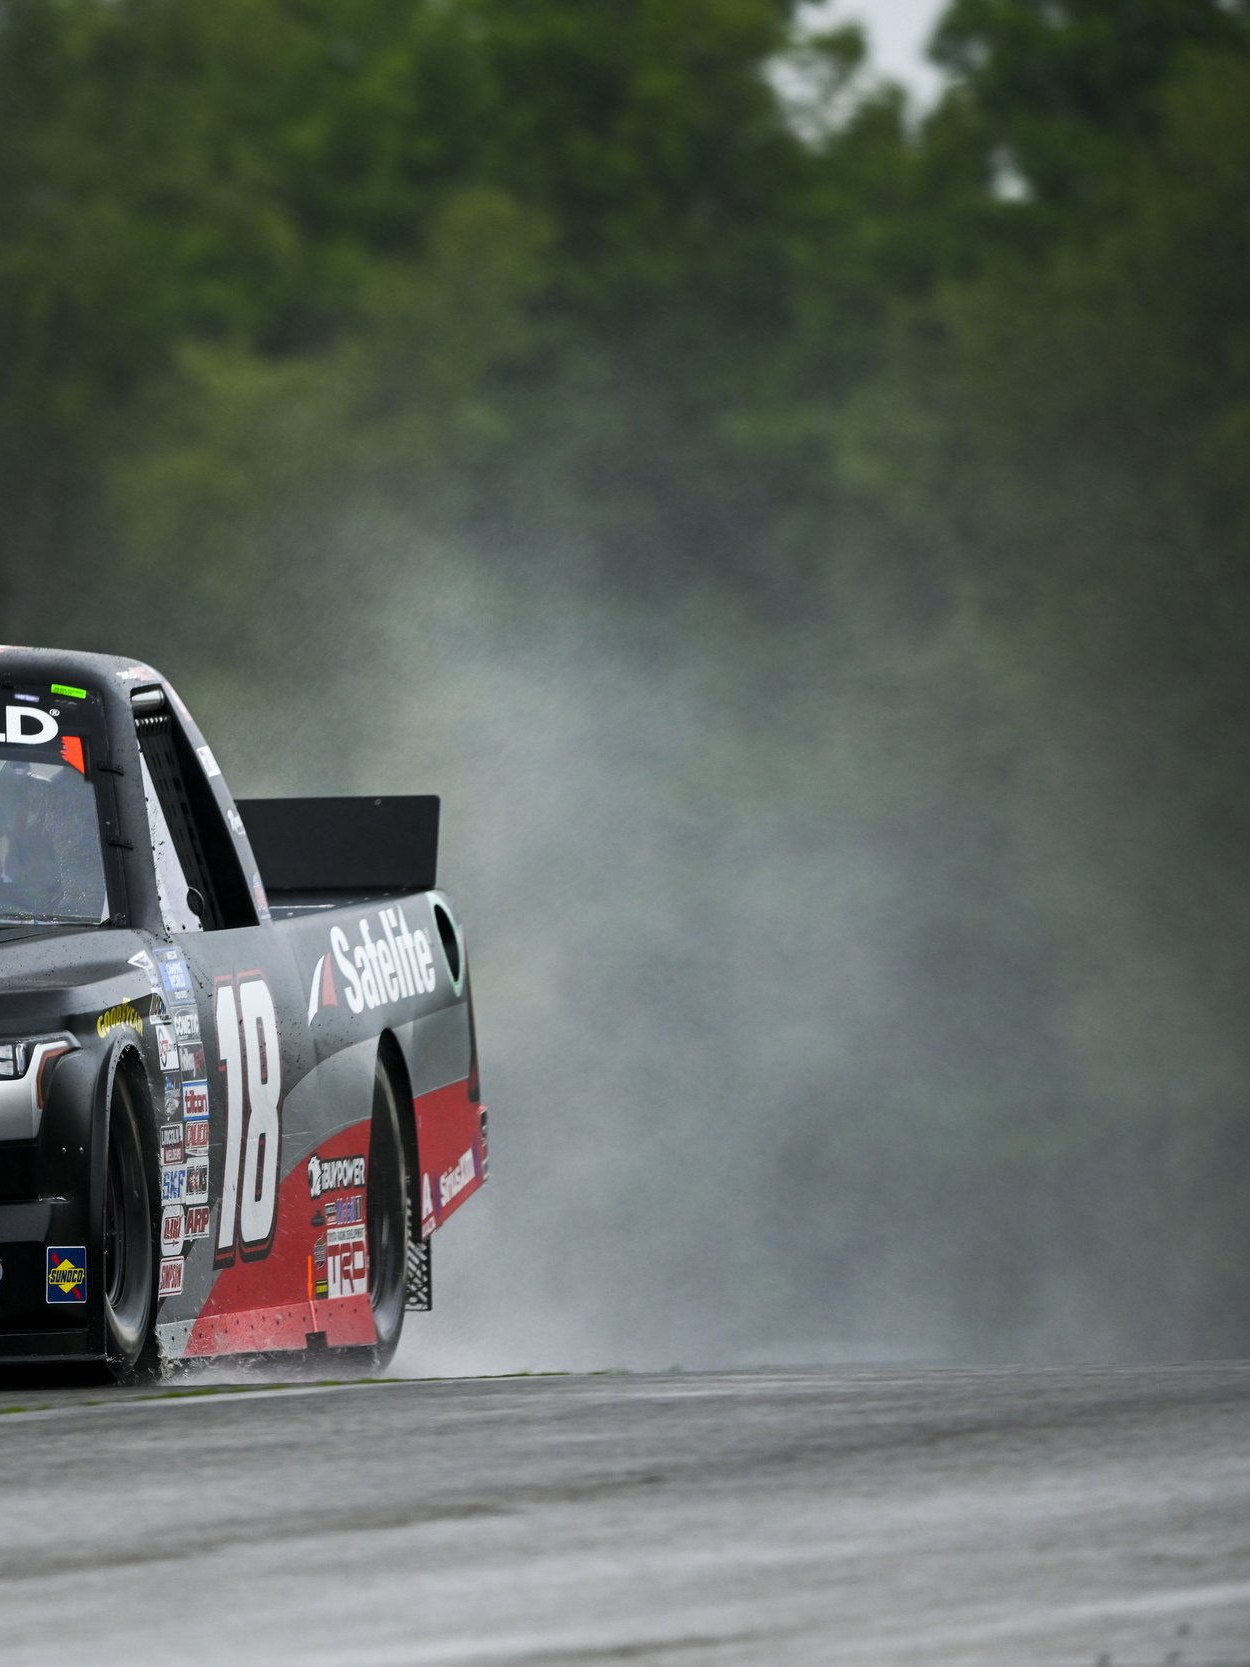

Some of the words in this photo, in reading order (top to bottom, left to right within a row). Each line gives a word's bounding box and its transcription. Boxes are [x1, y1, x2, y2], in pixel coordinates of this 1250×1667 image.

[330, 904, 437, 1014] Safelite
[215, 974, 282, 1256] 18
[162, 1169, 186, 1200] SKF
[185, 1207, 209, 1234] ARP
[49, 1268, 85, 1285] SUNOCO
[328, 1240, 367, 1295] TRD
